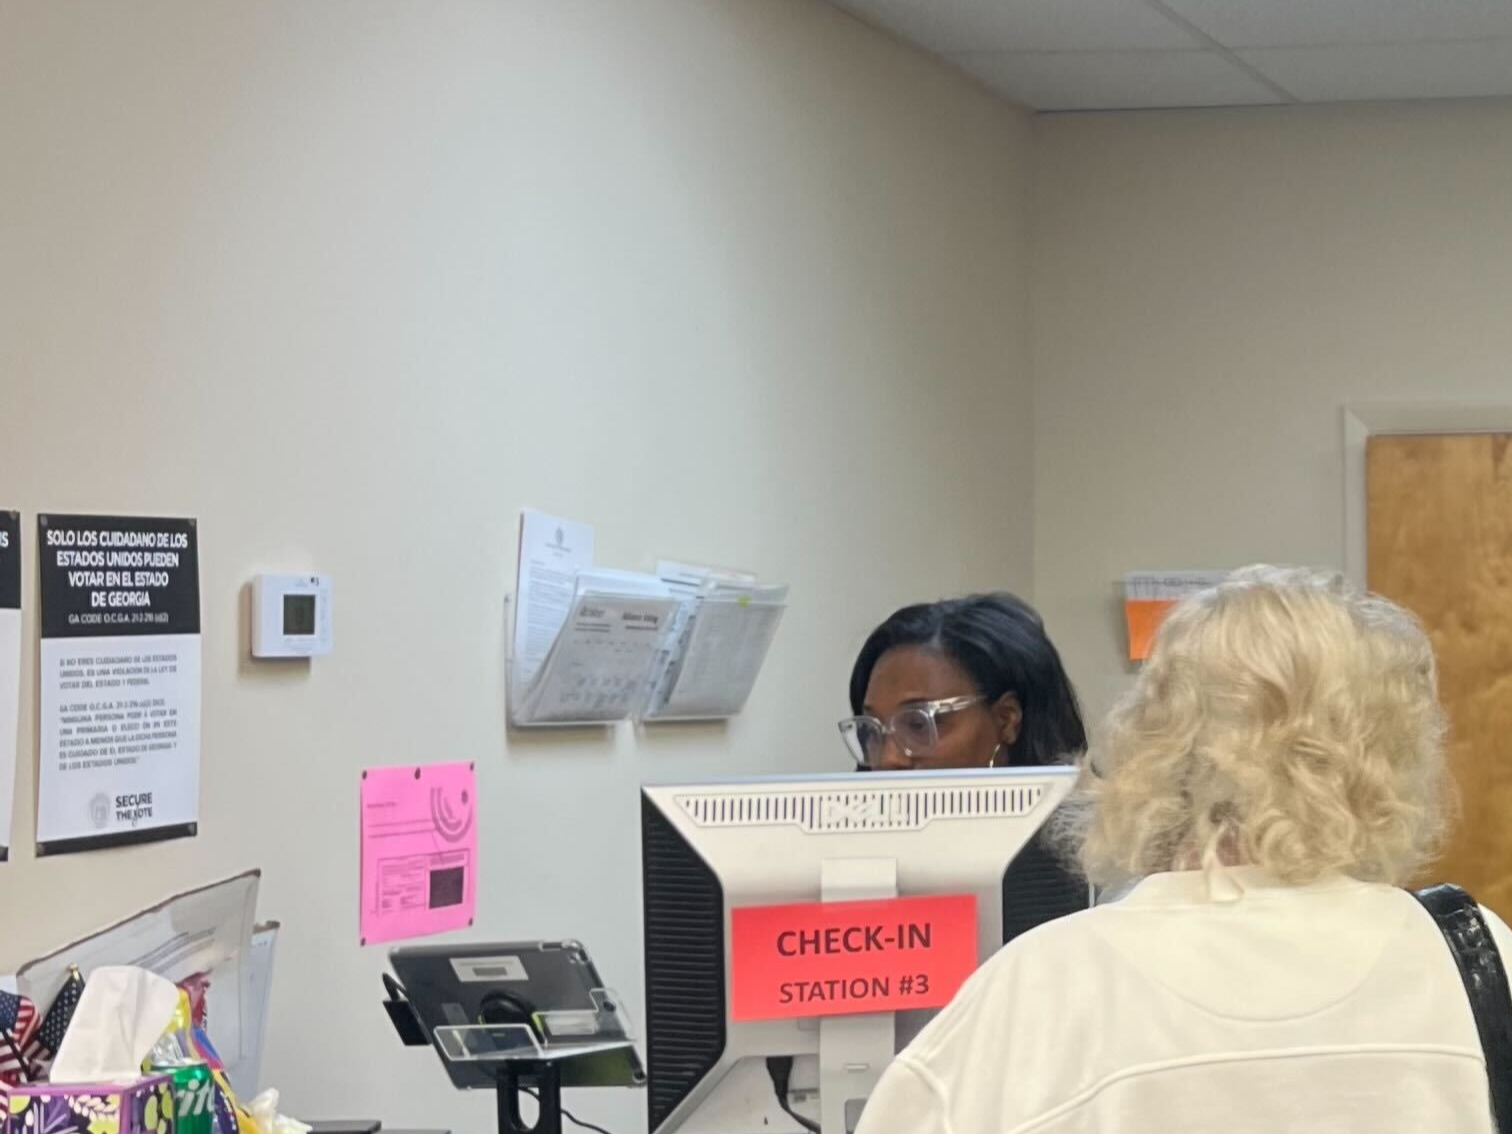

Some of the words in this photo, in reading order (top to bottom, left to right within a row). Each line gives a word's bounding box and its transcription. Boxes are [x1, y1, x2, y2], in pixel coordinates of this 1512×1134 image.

[47, 530, 76, 546] SOLO
[77, 530, 97, 546] LOS
[157, 533, 169, 547] DE
[170, 533, 188, 548] LOS
[57, 551, 104, 566] ESTADOS
[106, 552, 143, 567] UNIDOS
[144, 552, 179, 567] PUEDEN
[68, 571, 104, 587] VOTAR
[106, 572, 120, 587] EN
[122, 572, 133, 586] EL
[135, 572, 169, 586] ESTADO
[92, 592, 106, 607] DE
[108, 592, 150, 607] GEORGIA
[68, 613, 80, 624] GA
[81, 613, 101, 624] CODE
[116, 792, 152, 808] SECURE
[116, 810, 131, 820] THE
[777, 922, 931, 956] CHECK-IN
[779, 976, 889, 1004] STATION
[899, 974, 929, 996] #3
